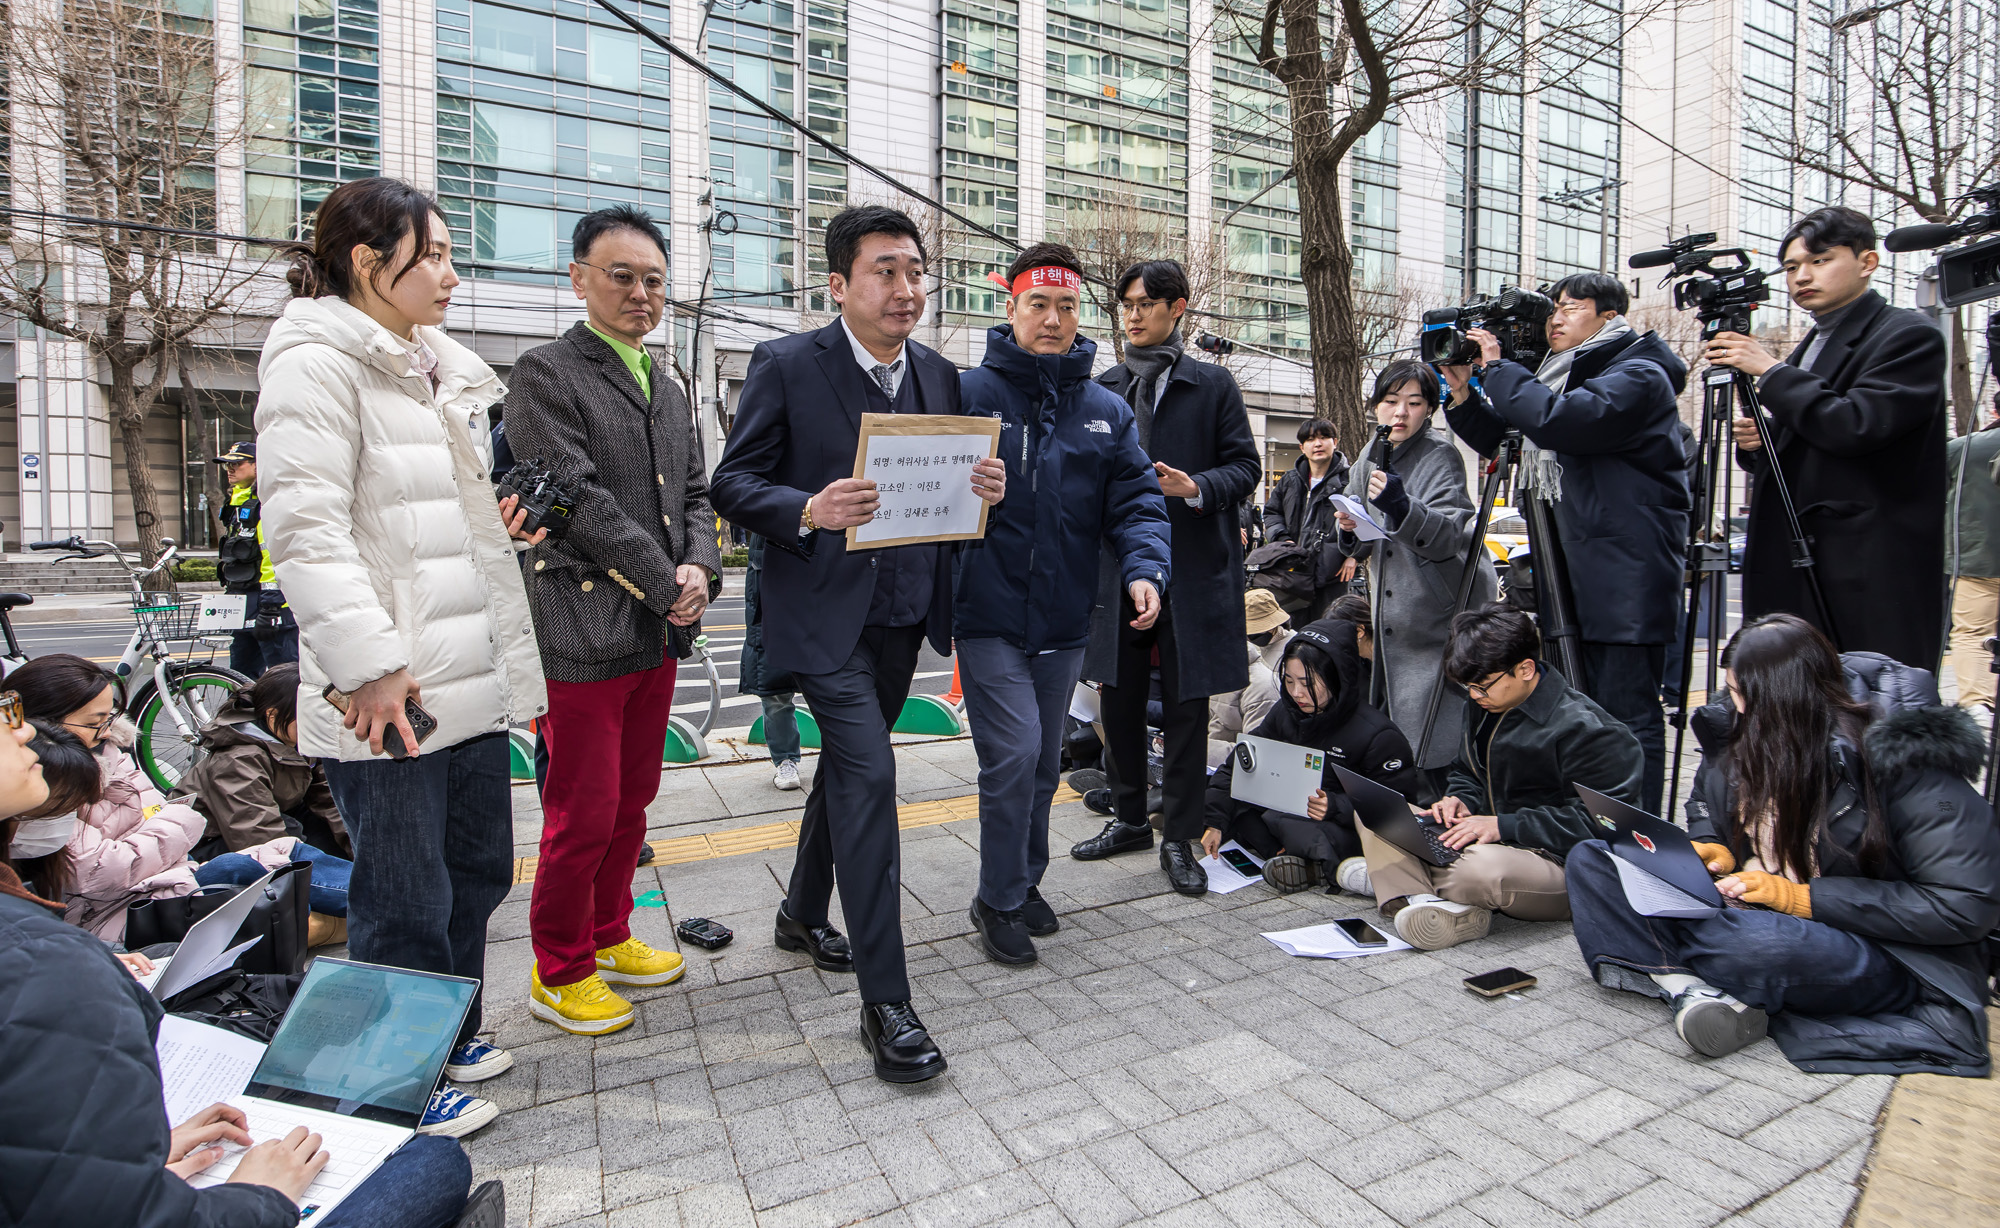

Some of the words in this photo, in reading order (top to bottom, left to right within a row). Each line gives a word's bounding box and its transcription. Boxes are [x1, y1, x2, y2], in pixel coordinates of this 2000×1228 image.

[1031, 267, 1062, 286] 탄핵
[872, 457, 893, 467] 죄명:
[897, 456, 930, 467] 허위사실
[933, 455, 947, 466] 유포
[874, 482, 905, 493] 고소인
[917, 480, 942, 492] 이진호
[873, 509, 891, 519] 소인
[903, 507, 930, 519] 김새론
[934, 505, 950, 517] 유족
